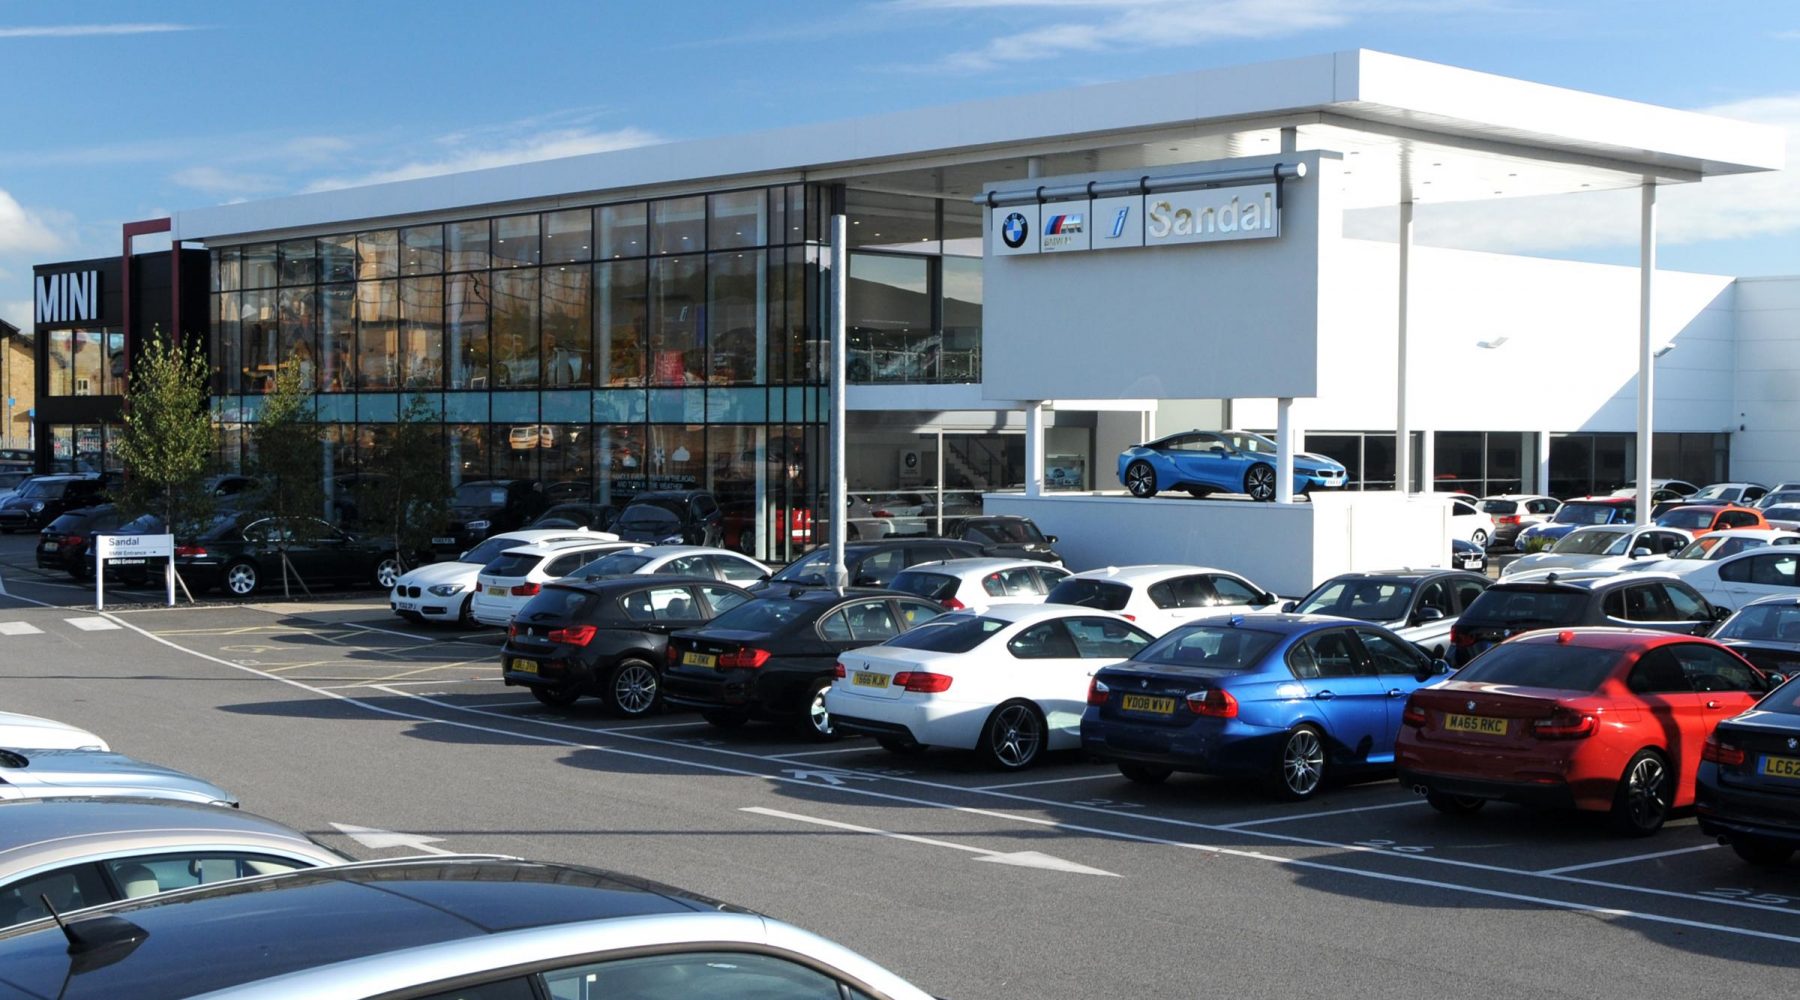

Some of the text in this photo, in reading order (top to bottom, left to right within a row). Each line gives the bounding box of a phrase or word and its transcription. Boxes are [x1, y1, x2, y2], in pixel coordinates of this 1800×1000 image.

[1148, 192, 1272, 238] Sandal
[36, 270, 97, 323] MINI
[108, 537, 140, 546] Sandal
[1126, 695, 1150, 710] YD08
[1480, 718, 1503, 732] RKC
[1766, 759, 1800, 777] LC62
[1353, 839, 1434, 853] 26
[1697, 887, 1800, 904] 25
